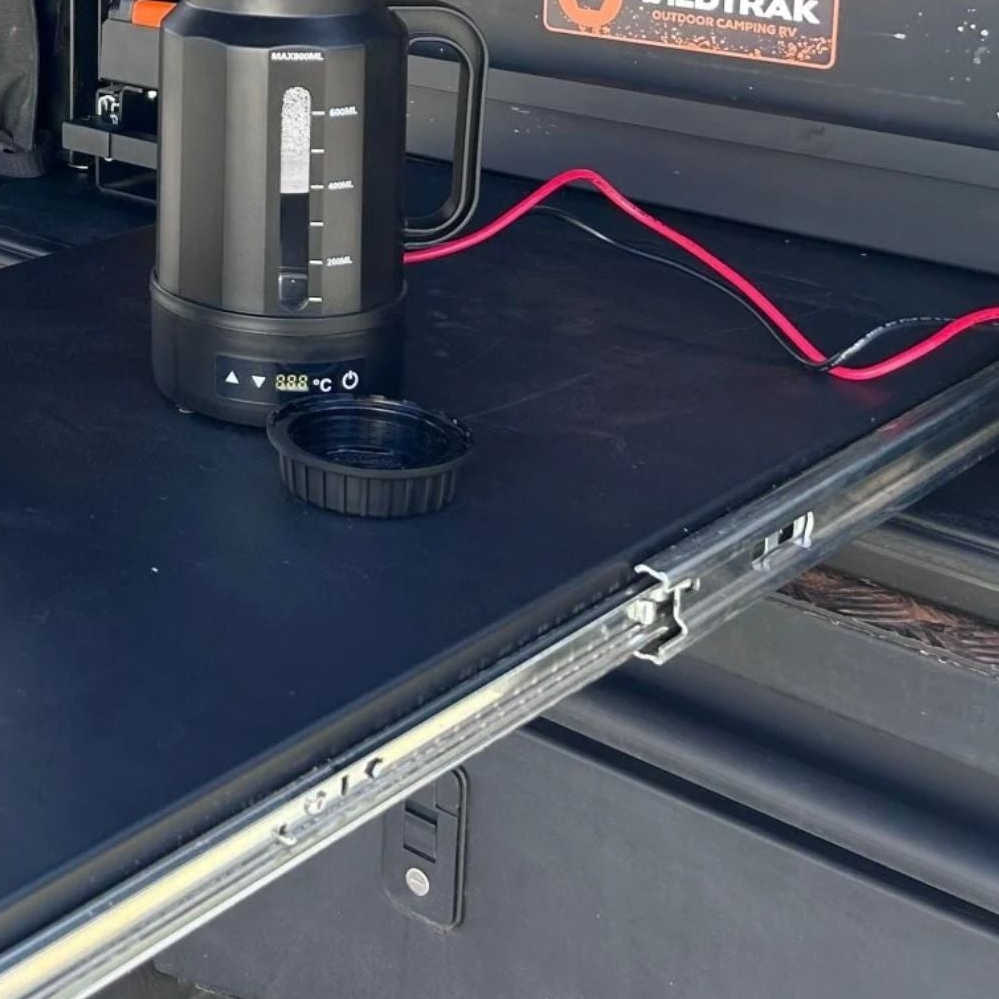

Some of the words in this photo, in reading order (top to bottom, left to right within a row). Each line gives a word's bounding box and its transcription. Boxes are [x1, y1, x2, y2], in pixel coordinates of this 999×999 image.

[651, 9, 714, 27] OUTDOOR
[715, 17, 777, 35] CAMPING
[778, 25, 798, 38] RV
